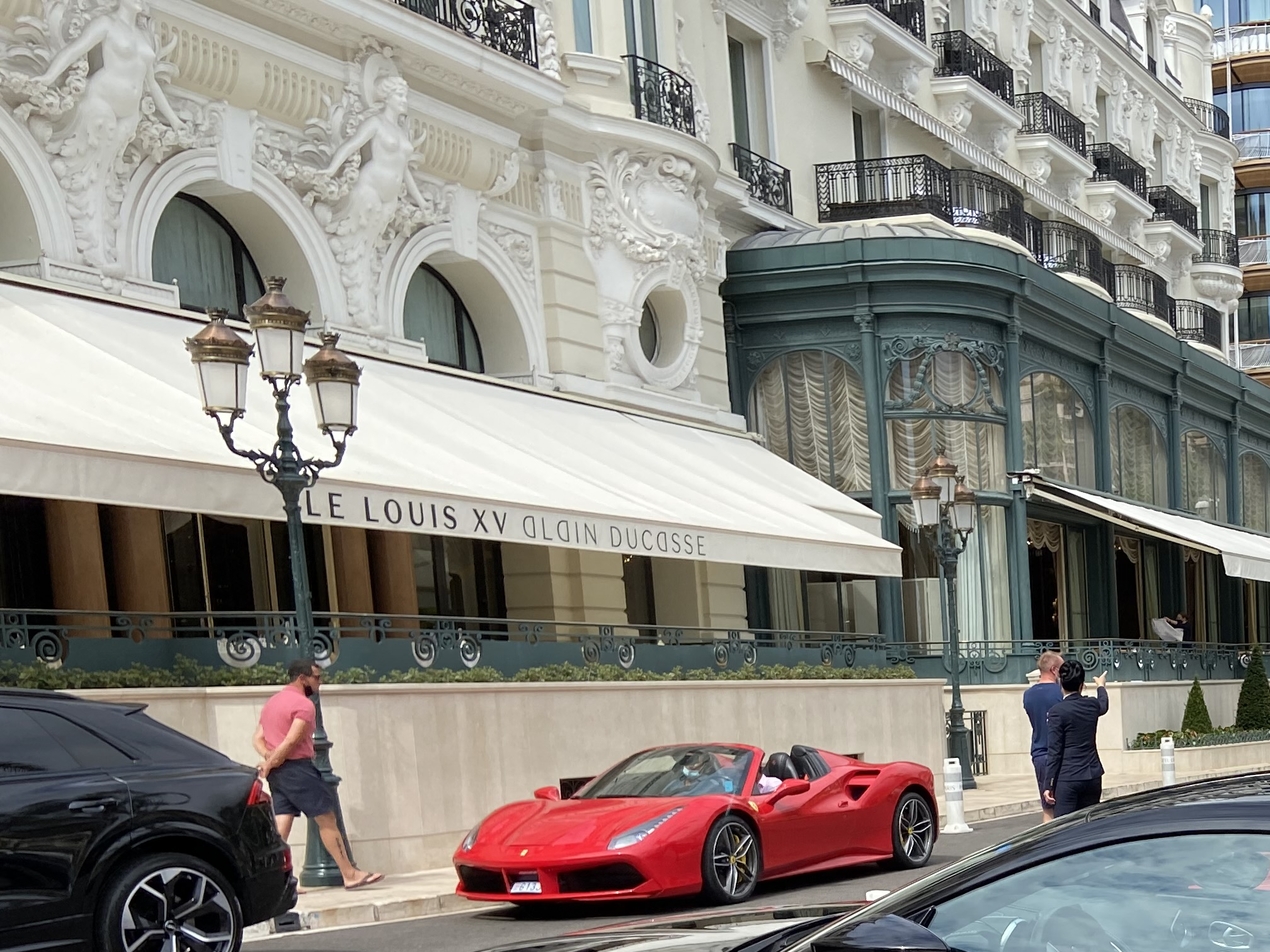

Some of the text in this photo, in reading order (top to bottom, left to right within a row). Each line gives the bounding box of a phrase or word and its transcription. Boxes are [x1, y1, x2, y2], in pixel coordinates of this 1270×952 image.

[305, 490, 345, 519] LE
[364, 496, 458, 530] LOUIS
[473, 508, 508, 535] XV
